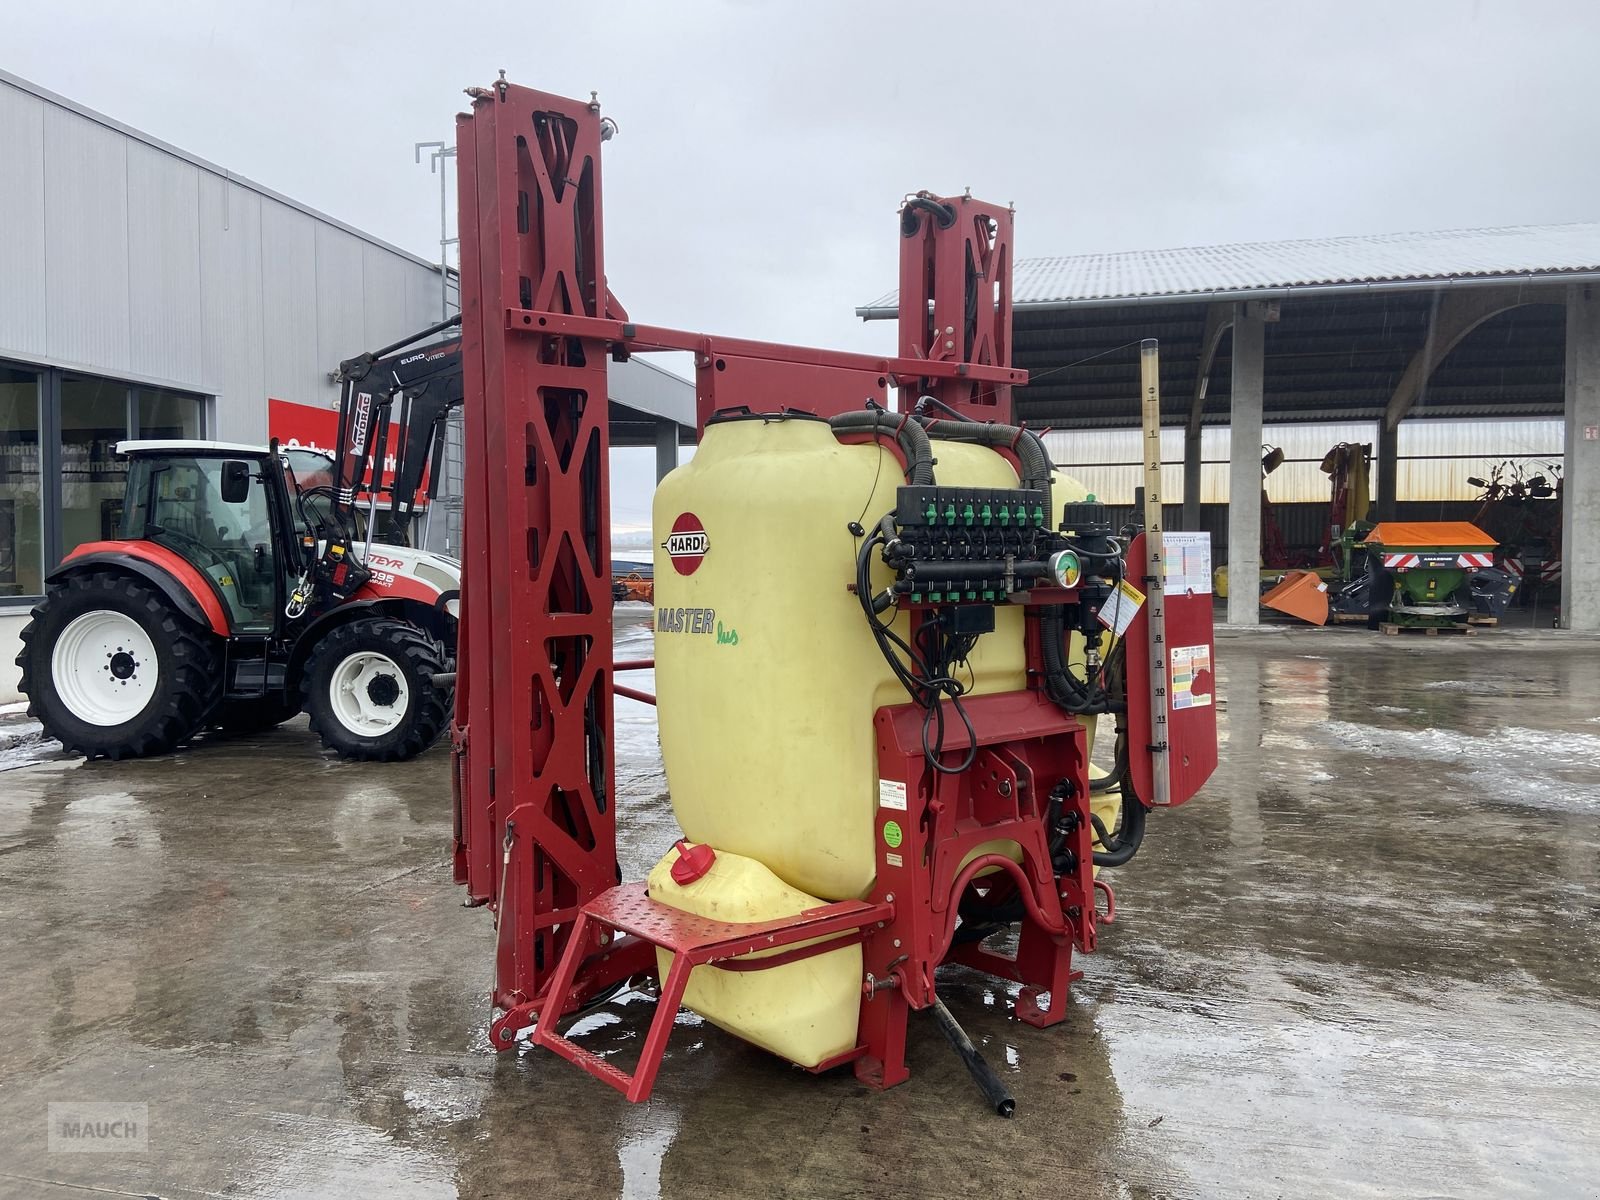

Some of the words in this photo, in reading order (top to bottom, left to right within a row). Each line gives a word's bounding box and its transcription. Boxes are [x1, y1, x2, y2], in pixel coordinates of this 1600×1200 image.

[400, 353, 425, 365] EURO
[356, 396, 371, 446] HYDRAC
[1151, 493, 1158, 501] 3
[1152, 523, 1158, 531] 4
[670, 537, 704, 552] HARDI
[1153, 553, 1159, 561] 5
[367, 553, 404, 570] TEYR
[1155, 608, 1161, 616] 7
[657, 607, 716, 635] MASTER
[1156, 634, 1162, 642] 8
[1156, 659, 1163, 667] 9
[1155, 687, 1165, 695] 10
[1157, 741, 1168, 750] 12
